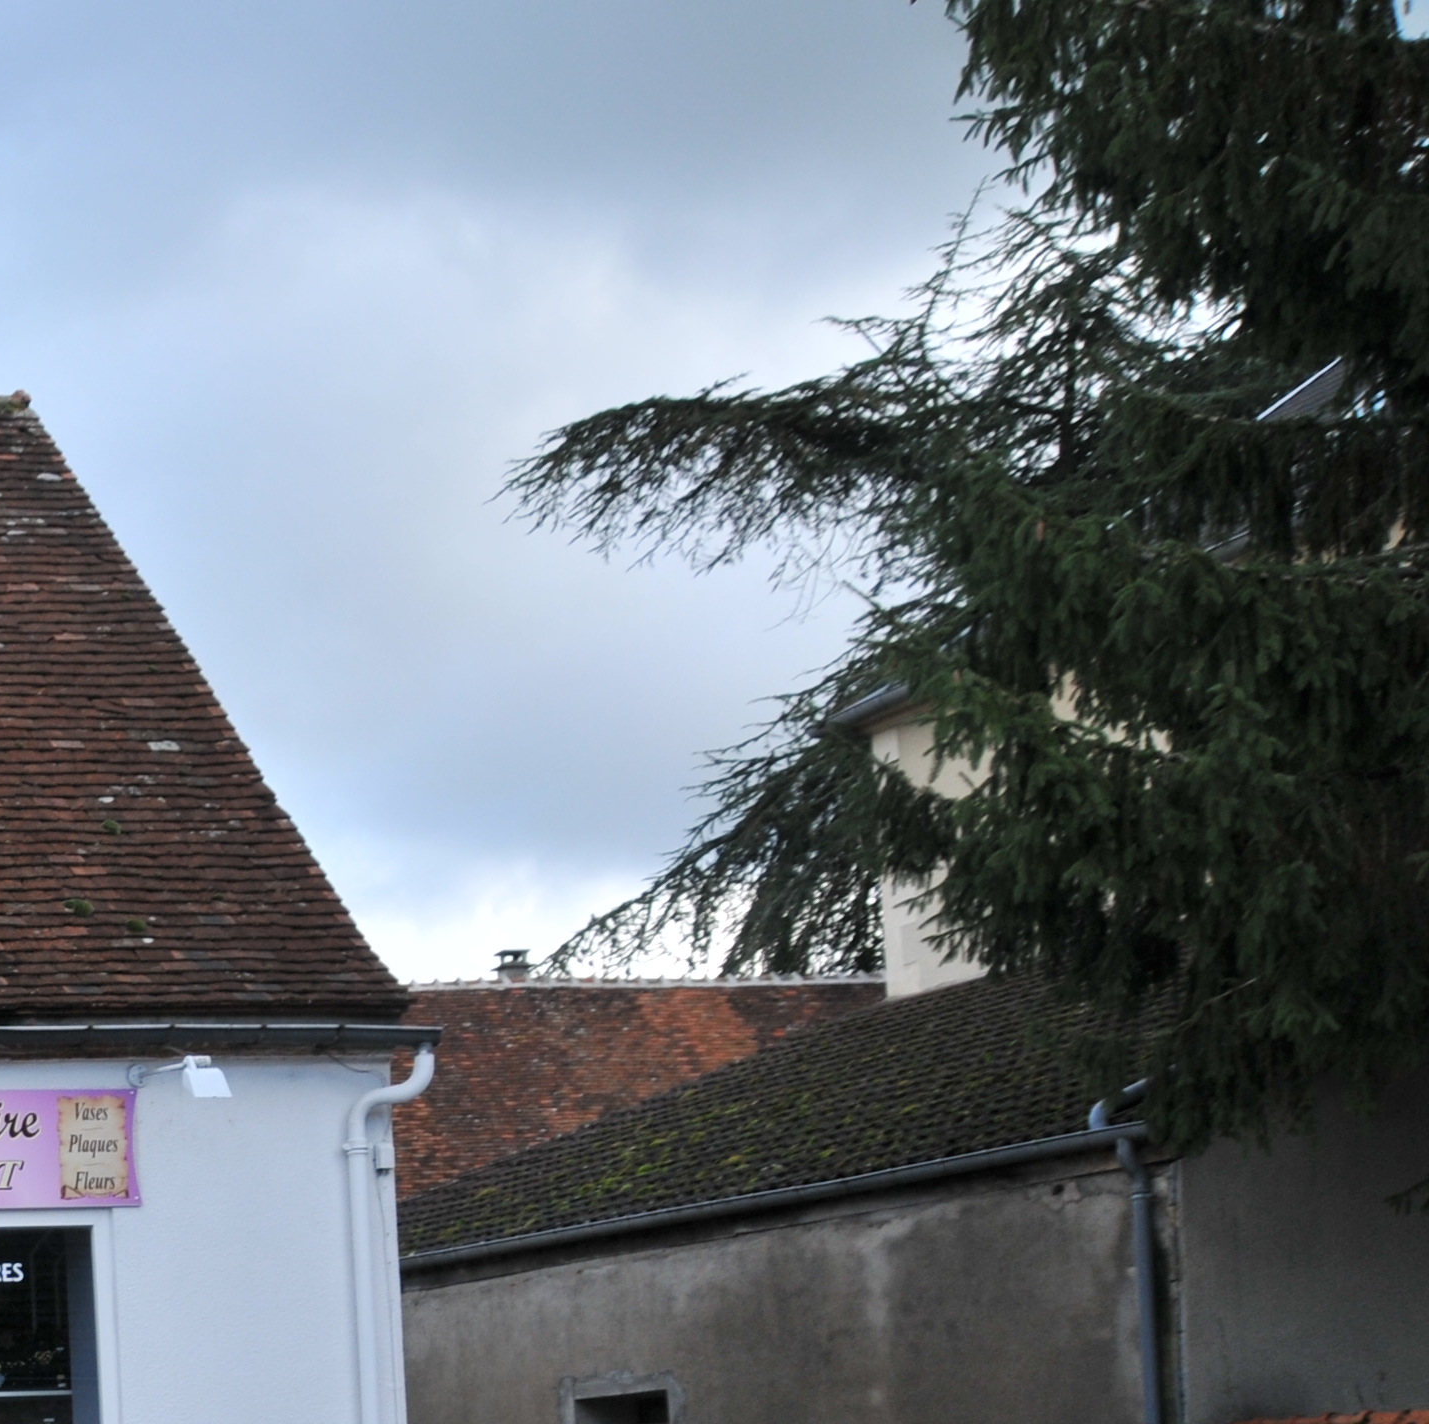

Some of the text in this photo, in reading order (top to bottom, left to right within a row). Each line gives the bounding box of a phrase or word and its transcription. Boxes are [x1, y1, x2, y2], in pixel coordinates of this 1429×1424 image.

[74, 1102, 108, 1121] Vases
[68, 1134, 119, 1157] Plaques
[74, 1171, 116, 1190] Fleurs
